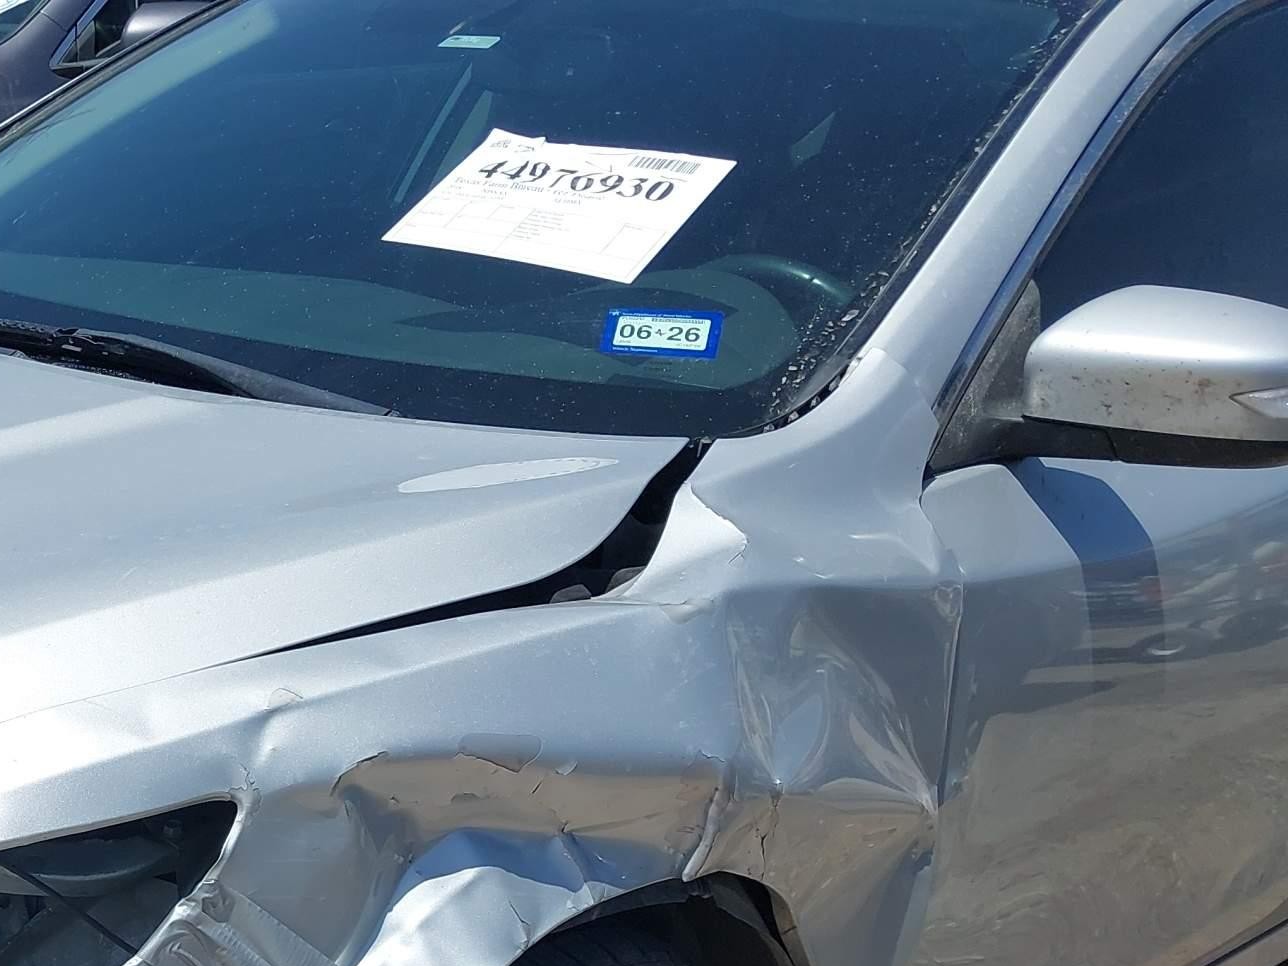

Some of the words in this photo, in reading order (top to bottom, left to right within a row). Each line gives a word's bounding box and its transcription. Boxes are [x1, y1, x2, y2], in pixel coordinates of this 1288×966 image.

[478, 159, 675, 202] 44976930
[619, 323, 652, 340] 06
[666, 326, 701, 342] 26
